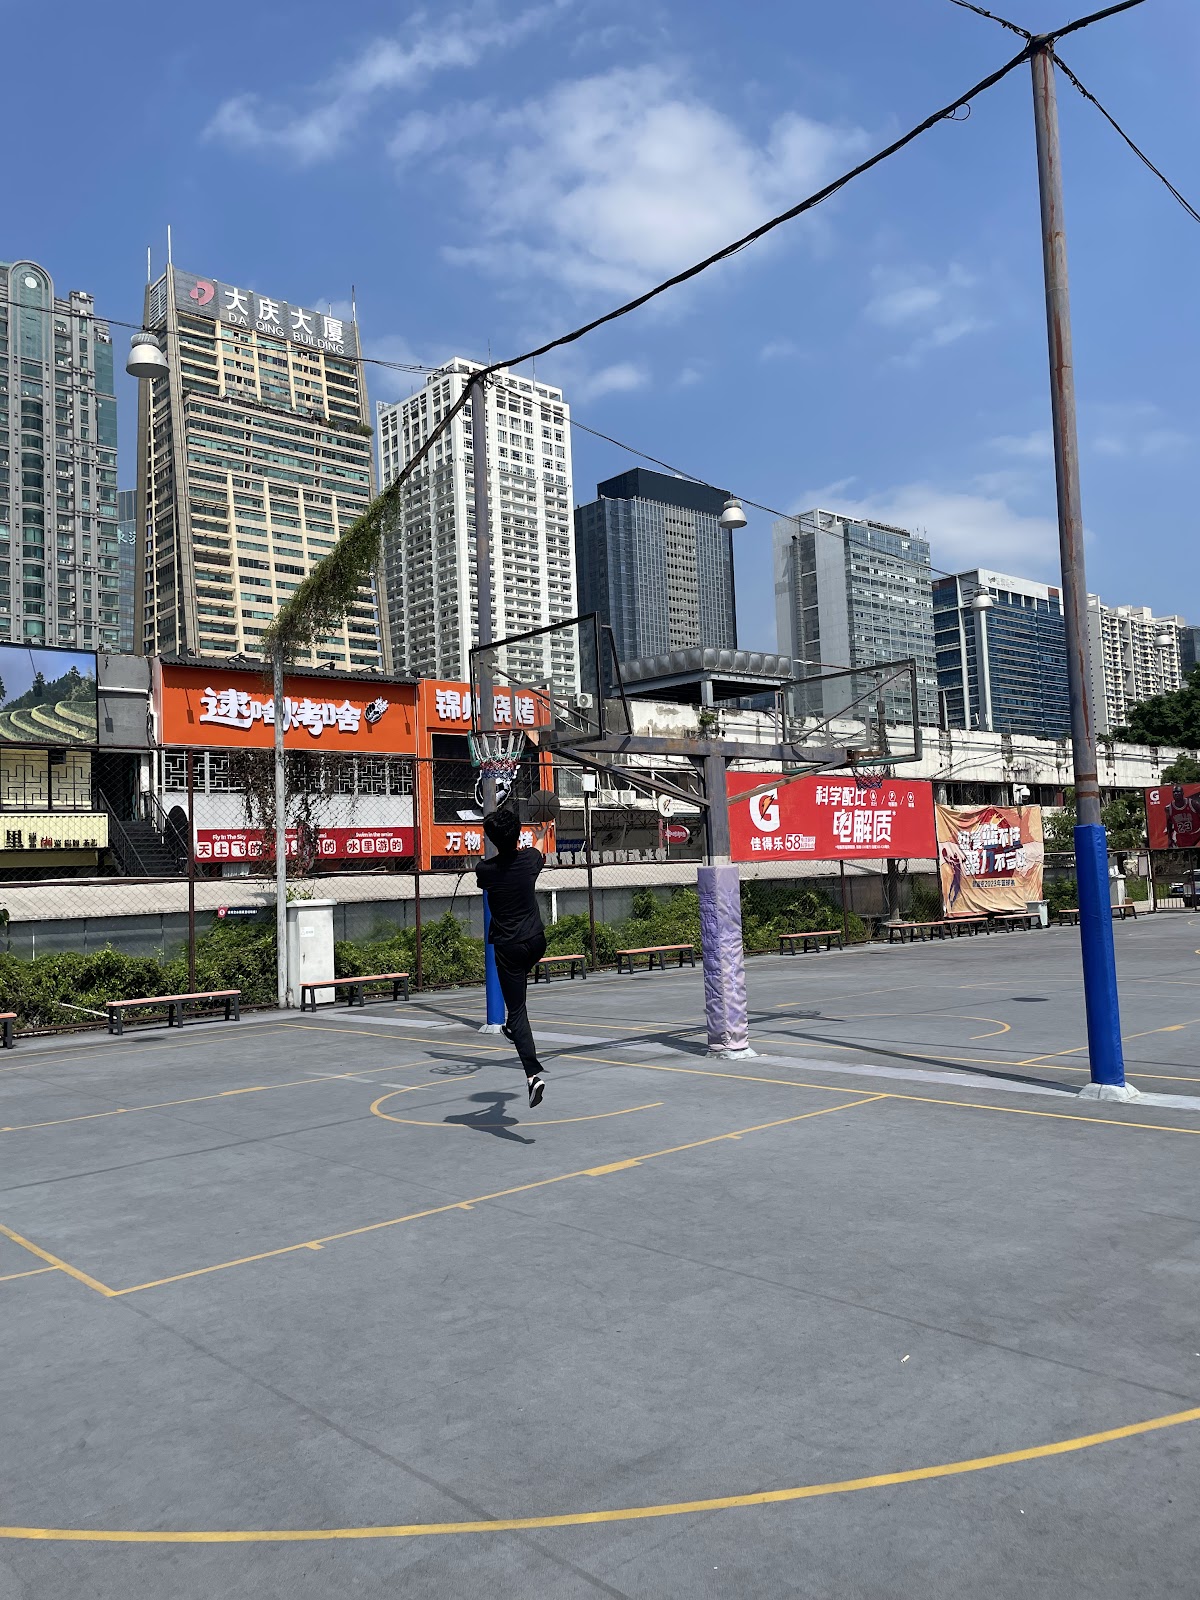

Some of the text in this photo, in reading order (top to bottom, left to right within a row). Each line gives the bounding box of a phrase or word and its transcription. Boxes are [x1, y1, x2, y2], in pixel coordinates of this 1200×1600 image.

[225, 287, 345, 345] 大庆大厦
[228, 310, 345, 355] DA QING BUILDING
[435, 688, 535, 725] 锦州烧烤
[815, 786, 867, 807] 科学配比
[1149, 790, 1160, 802] G
[749, 784, 781, 833] G
[832, 808, 893, 844] 电解质
[1177, 821, 1193, 834] 23
[197, 842, 262, 857] 天上飞的
[347, 838, 402, 853] 水里游的
[750, 836, 784, 851] 佳得乐
[786, 834, 801, 850] 58
